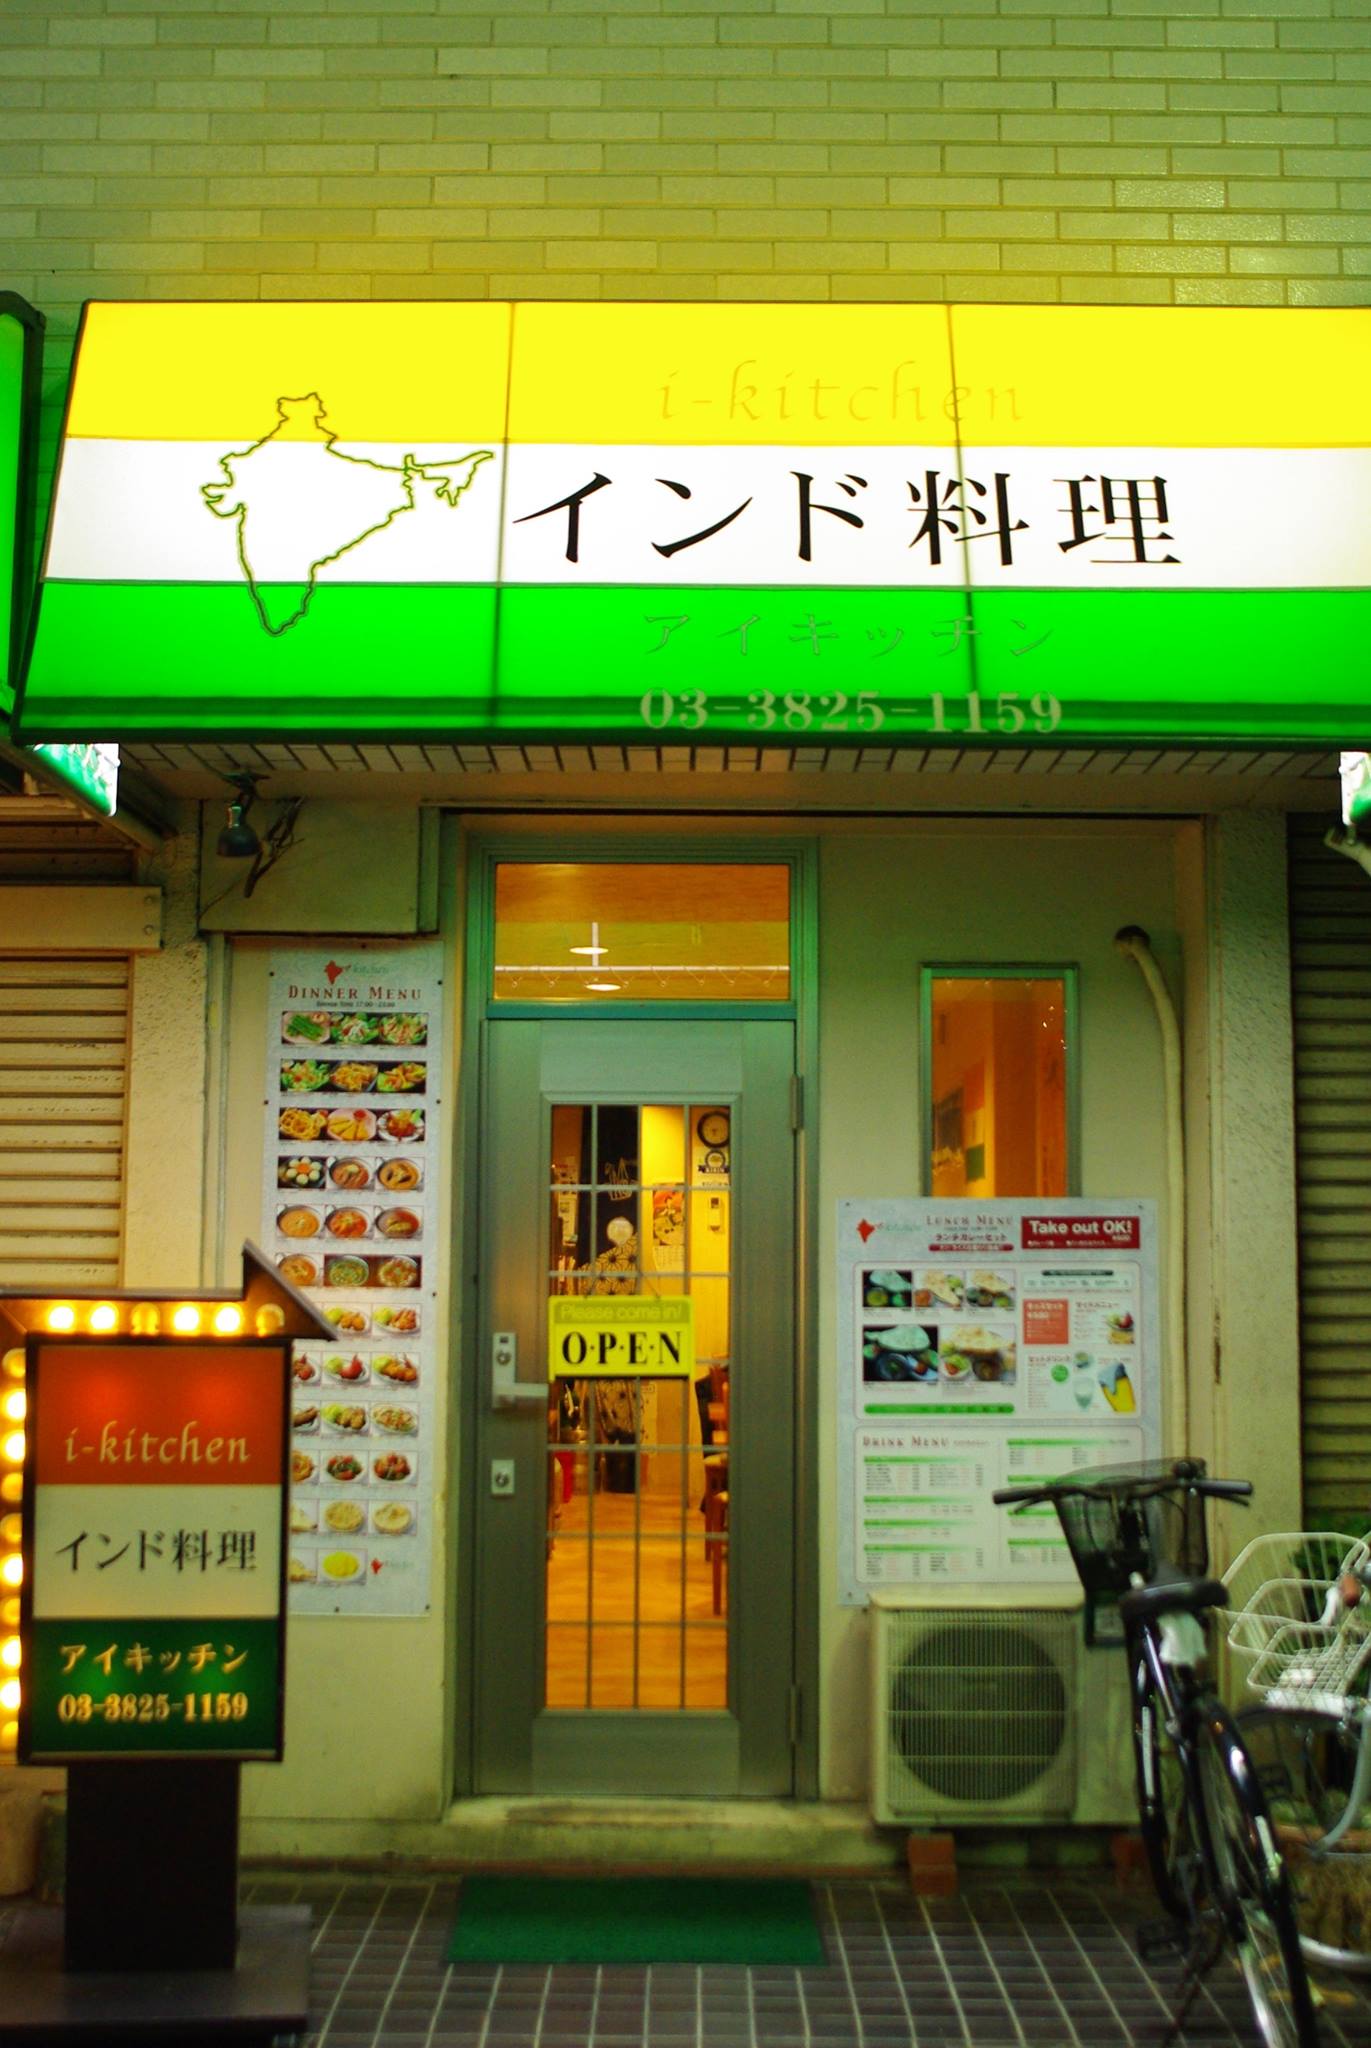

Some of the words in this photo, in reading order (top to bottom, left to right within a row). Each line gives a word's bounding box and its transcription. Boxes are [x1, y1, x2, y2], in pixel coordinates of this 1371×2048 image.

[658, 358, 1025, 423] i-kitchen
[512, 470, 1183, 566] インド料理
[643, 612, 1054, 658] アイキッチン
[639, 688, 1064, 735] 03-3825-1159
[1029, 1220, 1069, 1234] Take
[1072, 1221, 1099, 1234] out
[1103, 1219, 1133, 1234] OK!
[561, 1304, 614, 1319] Please
[618, 1306, 660, 1319] come
[64, 1420, 251, 1466] i-kitchen
[55, 1528, 258, 1574] インド料理
[59, 1641, 250, 1676] アイキッチン
[57, 1692, 250, 1723] 03-3825-1159
